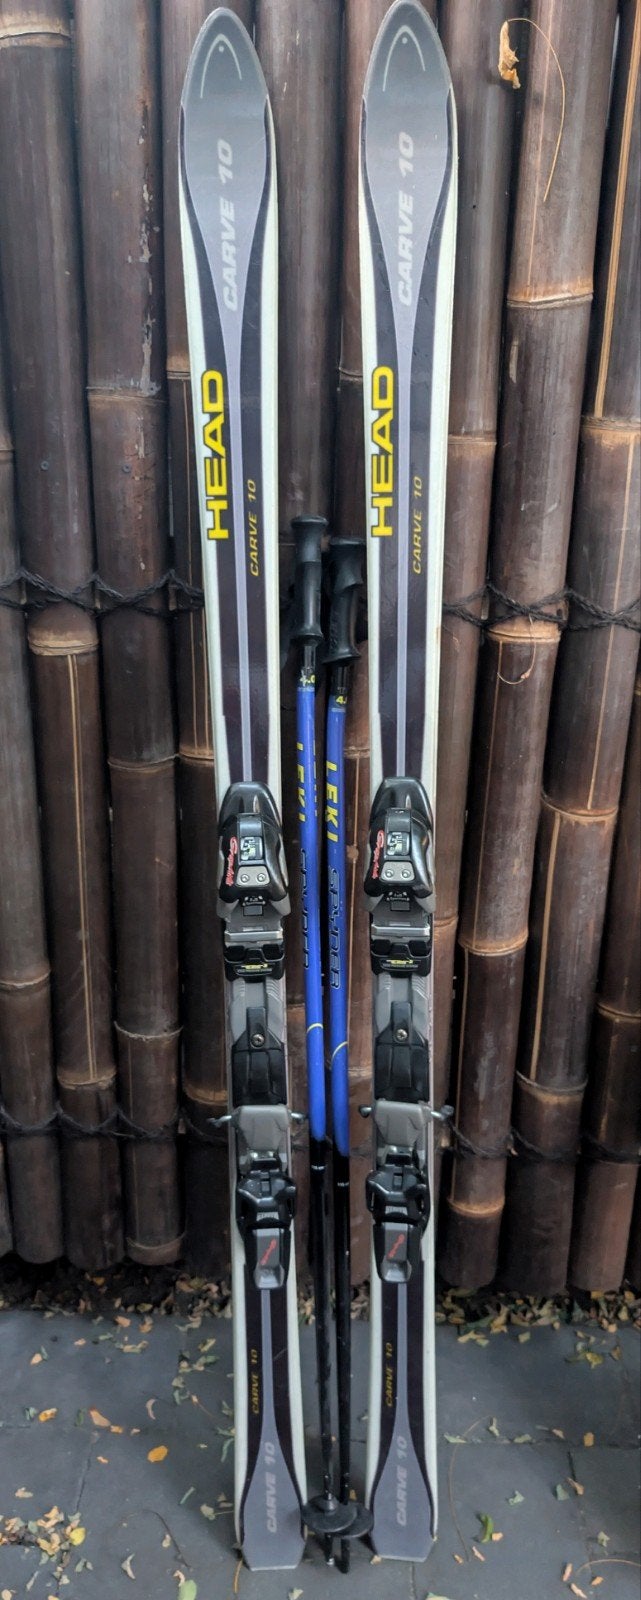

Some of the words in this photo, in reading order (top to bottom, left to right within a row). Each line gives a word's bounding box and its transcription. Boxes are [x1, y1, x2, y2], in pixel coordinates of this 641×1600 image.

[217, 138, 233, 184] 10
[399, 131, 414, 178] 10
[220, 197, 238, 312] CARVE
[397, 190, 414, 306] CARVE
[201, 370, 229, 540] HEAD
[371, 366, 394, 537] HEAD
[248, 479, 256, 502] 10
[413, 476, 423, 500] 10
[249, 511, 260, 576] CARVE
[411, 510, 424, 575] CARVE
[326, 760, 339, 843] LEKI
[264, 1441, 275, 1466] 10
[265, 1472, 278, 1534] CARVE
